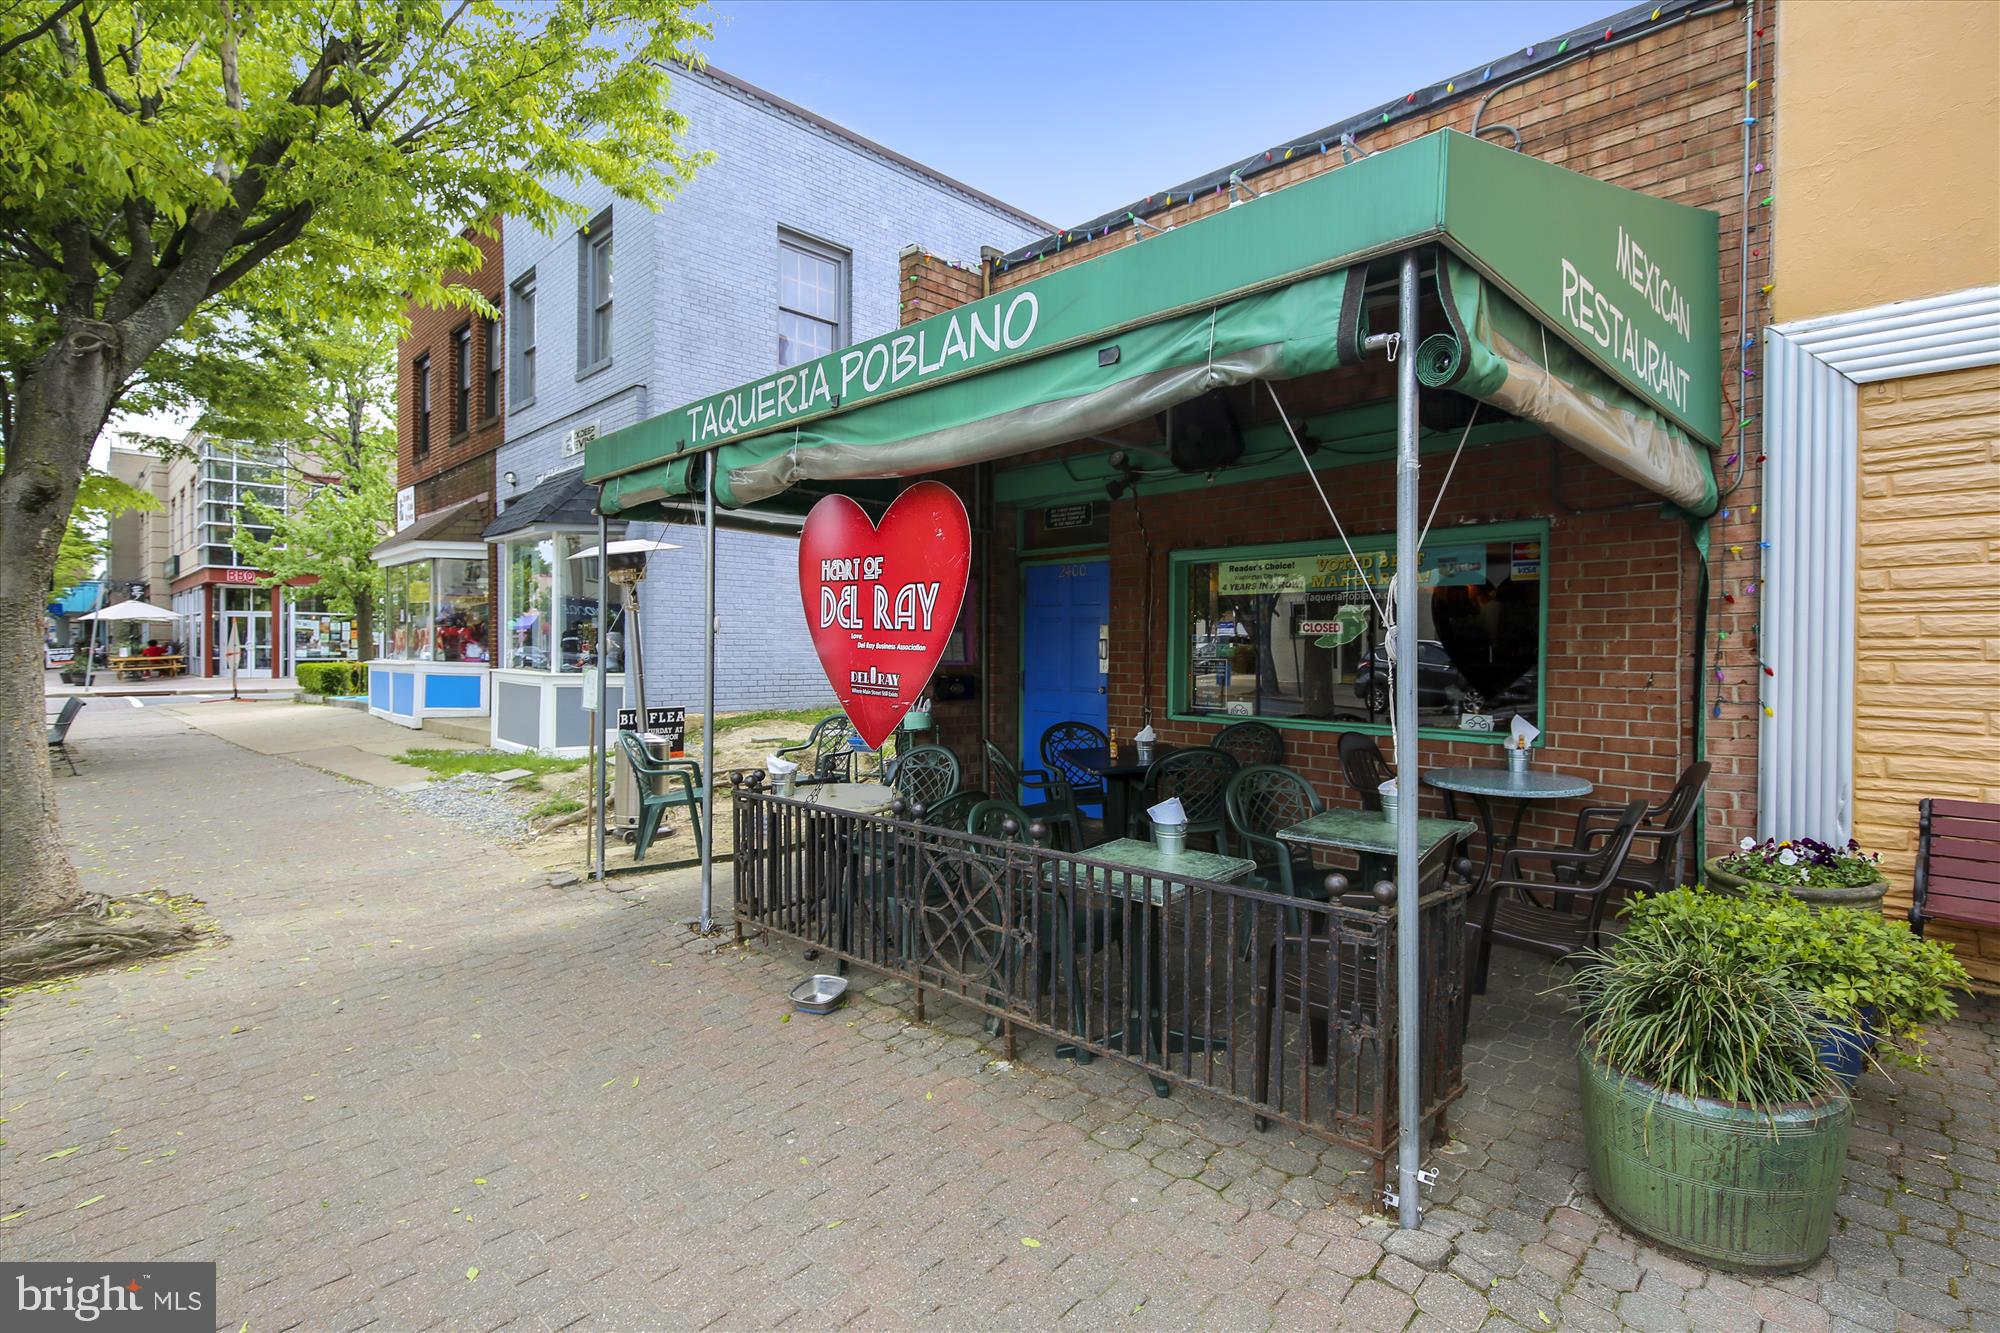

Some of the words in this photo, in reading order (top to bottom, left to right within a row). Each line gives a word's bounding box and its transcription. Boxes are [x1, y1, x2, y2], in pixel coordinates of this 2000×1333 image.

[1615, 225, 1691, 343] MEXICAN
[1561, 258, 1691, 413] RESTAURANT
[686, 361, 830, 442] TAQUERIA
[840, 291, 1039, 398] POBLANO
[821, 558, 861, 581] HEART
[863, 556, 884, 580] OF
[1229, 564, 1262, 572] Reader's
[1265, 562, 1296, 570] Choice!
[1316, 556, 1373, 572] VOTED
[226, 569, 255, 583] BBQ
[1230, 583, 1256, 591] YEARS
[820, 584, 863, 629] DEL
[873, 582, 940, 631] RAY
[1302, 622, 1341, 633] CLOSED
[857, 641, 866, 650] Del
[866, 642, 876, 651] Ray
[876, 642, 897, 650] Business
[897, 643, 926, 652] Association
[850, 671, 869, 684] DEL
[877, 673, 900, 686] RAY
[620, 713, 638, 726] BI
[649, 711, 684, 724] FLEA
